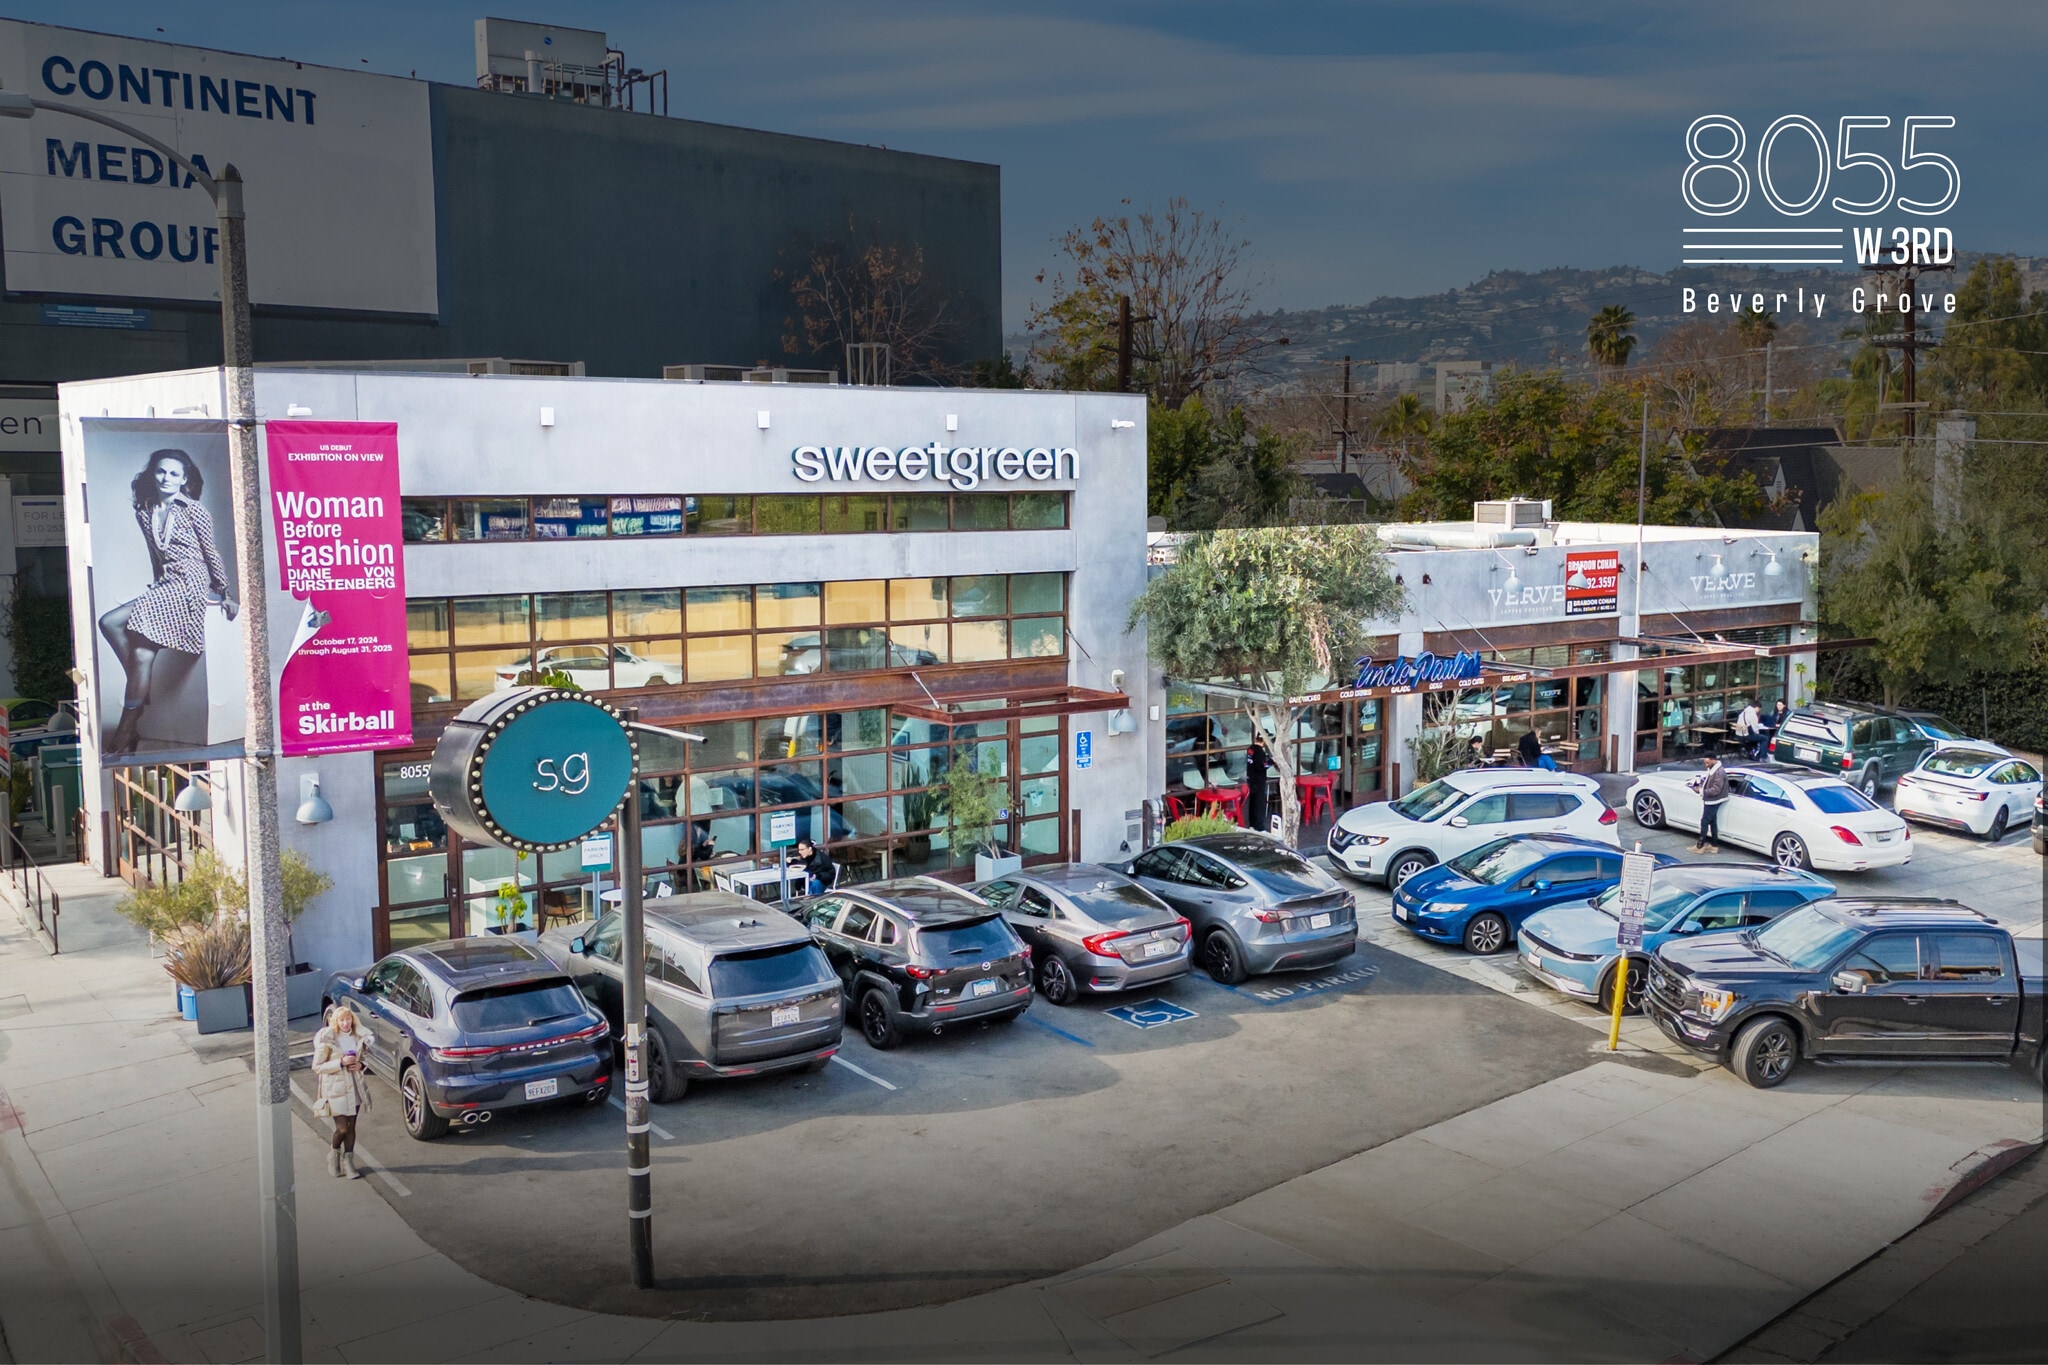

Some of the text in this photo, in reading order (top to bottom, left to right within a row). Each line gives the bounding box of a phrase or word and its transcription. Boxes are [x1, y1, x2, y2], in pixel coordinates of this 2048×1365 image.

[42, 55, 316, 125] CONTINENT
[46, 138, 213, 189] MEDIA
[288, 453, 384, 462] EXHIBITION ON VIEW
[793, 441, 1080, 490] sweetgreen
[276, 491, 384, 519] Woman
[24, 511, 48, 520] FOR
[283, 521, 342, 538] Before
[285, 538, 394, 567] Fashion
[287, 567, 395, 580] DIANE VON
[1690, 572, 1756, 592] VERVE
[288, 578, 396, 592] FURSTENBERG
[1488, 585, 1565, 606] VERVE
[312, 638, 345, 646] October
[358, 636, 378, 644] 2024
[298, 647, 330, 657] through
[331, 646, 360, 656] August
[1353, 655, 1411, 688] Uncle
[299, 701, 331, 712] at the
[298, 710, 395, 735] Skirball
[400, 765, 429, 778] 8055
[533, 752, 590, 794] sg
[1254, 987, 1294, 1000] NO
